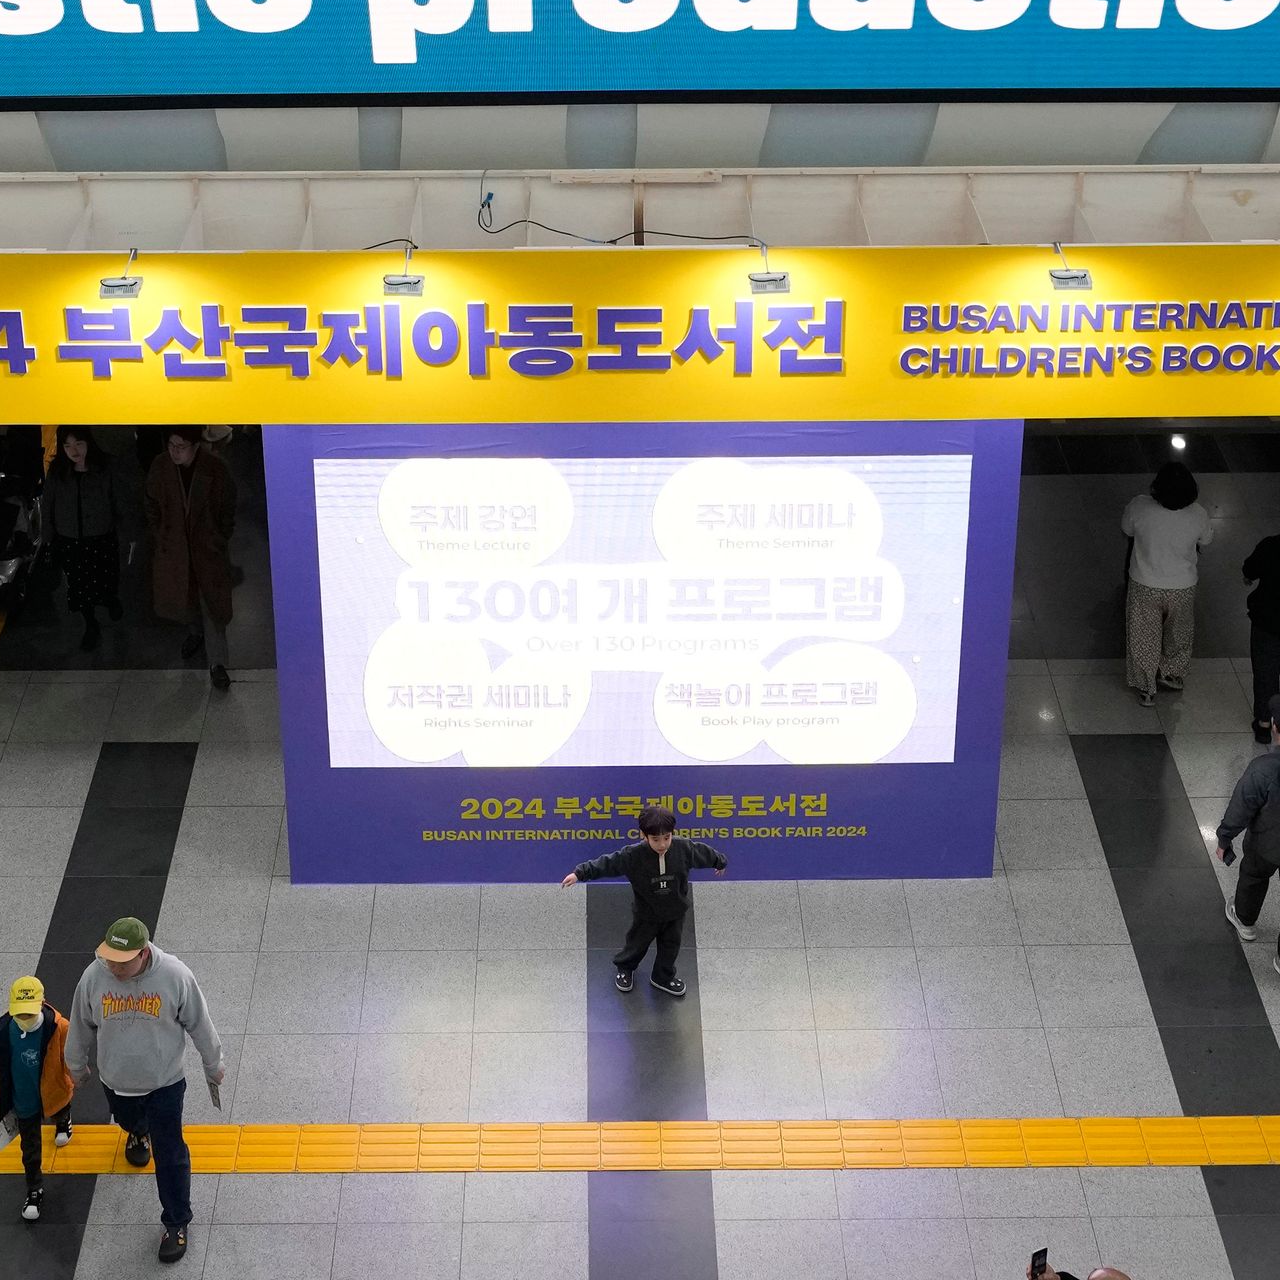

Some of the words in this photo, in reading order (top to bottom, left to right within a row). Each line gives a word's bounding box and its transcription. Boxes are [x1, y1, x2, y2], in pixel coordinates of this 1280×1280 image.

[903, 304, 1050, 332] BUSAN
[59, 300, 843, 377] 부산국제아동도서전
[901, 343, 1151, 374] CHILDREN'S
[1163, 344, 1280, 371] BOOK
[408, 504, 469, 534] 주제
[478, 504, 537, 533] 강연
[696, 503, 756, 531] 주제
[768, 502, 856, 530] 세미나
[417, 540, 470, 552] Theme
[474, 540, 531, 552] Lecture
[717, 538, 769, 550] Theme
[773, 538, 835, 549] Seminar
[407, 578, 578, 624] 130여
[597, 577, 648, 624] 개
[666, 575, 884, 622] 프로그램
[526, 636, 583, 653] Over
[593, 635, 635, 652] 130
[641, 635, 760, 656] Programs
[387, 684, 473, 710] 저작권
[483, 684, 572, 710] 세미나
[665, 683, 751, 708] 책놀이
[760, 681, 878, 707] 프로그램
[424, 716, 472, 730] Rights
[474, 716, 535, 729] Seminar
[701, 716, 739, 727] Book
[743, 715, 773, 728] Play
[776, 715, 840, 728] program
[460, 797, 546, 820] 2024
[422, 830, 482, 841] BUSAN
[485, 829, 625, 841] INTERNATIONAL
[627, 826, 730, 840] CDREN'S
[733, 827, 782, 838] BOOK
[785, 826, 823, 837] FAIR
[826, 826, 867, 837] 2024
[102, 992, 162, 1019] THRASHER
